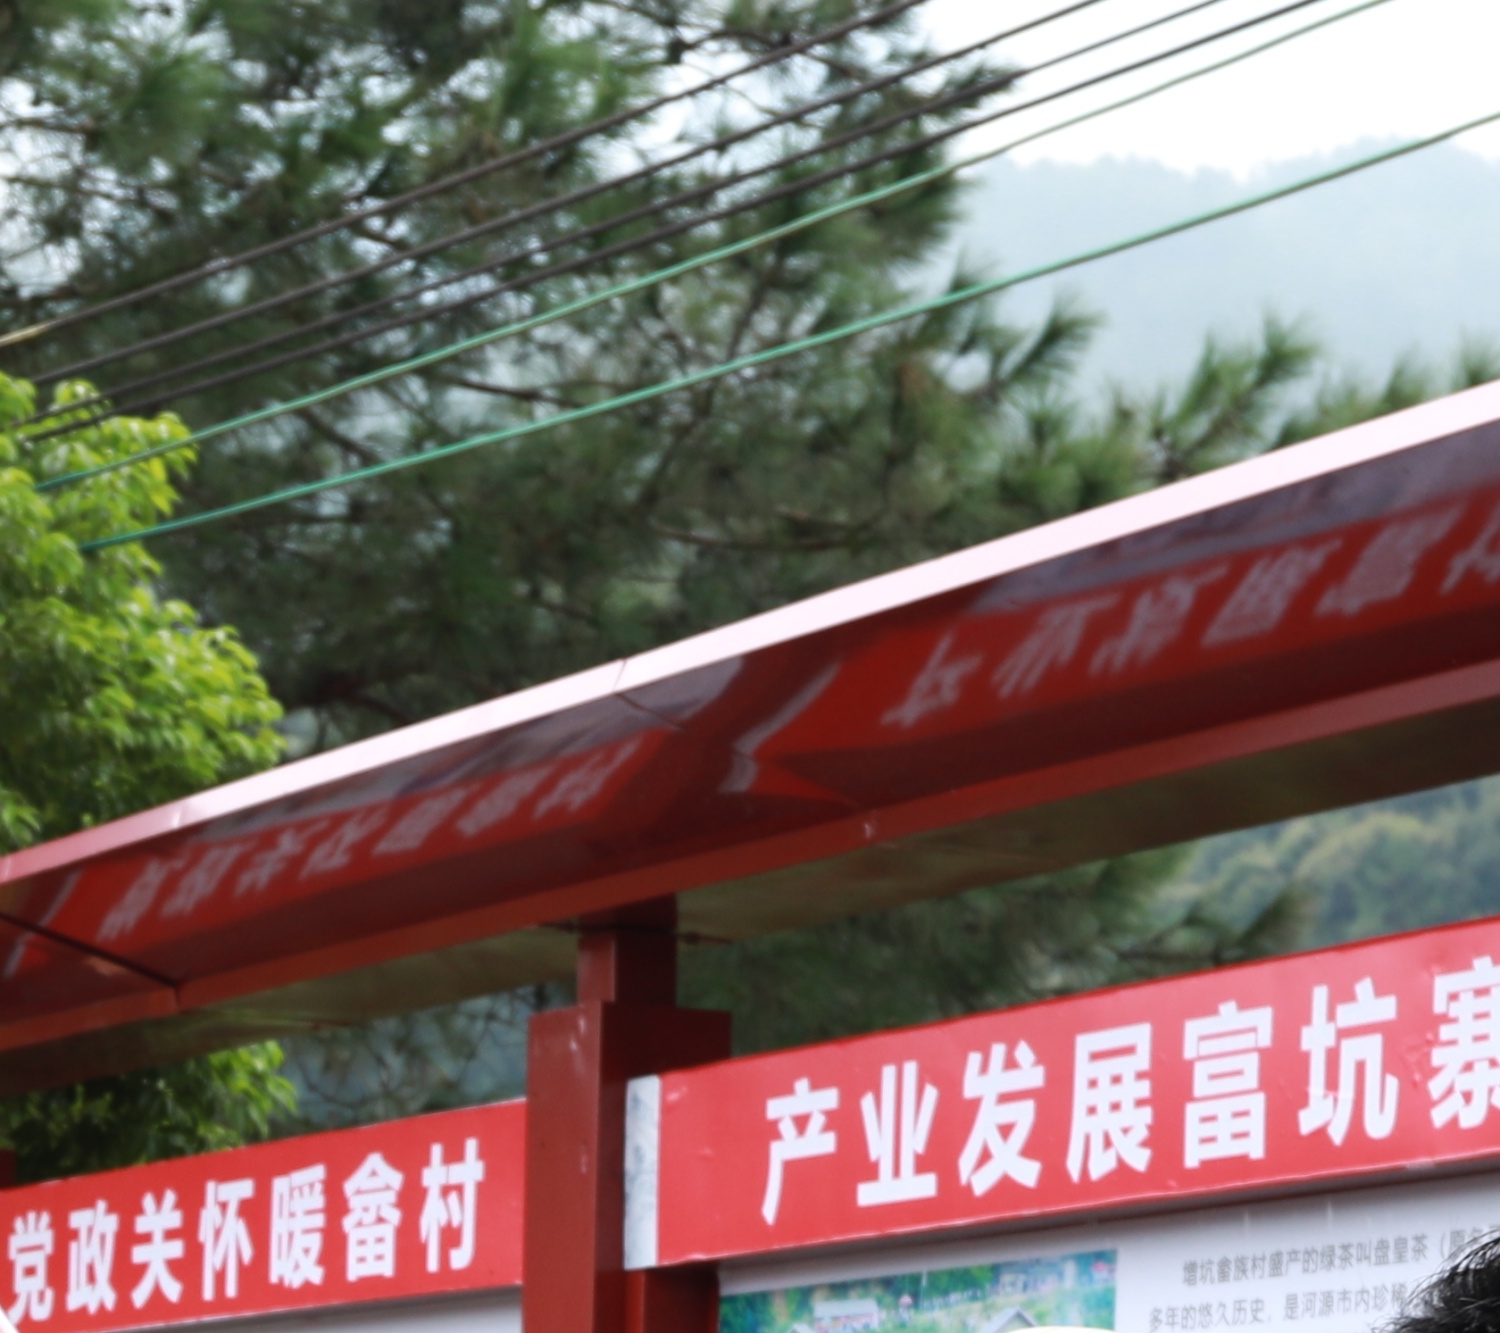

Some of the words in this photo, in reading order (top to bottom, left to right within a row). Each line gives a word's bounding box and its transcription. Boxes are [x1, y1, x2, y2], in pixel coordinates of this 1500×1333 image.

[7, 1136, 486, 1326] 党政关怀暖畲村
